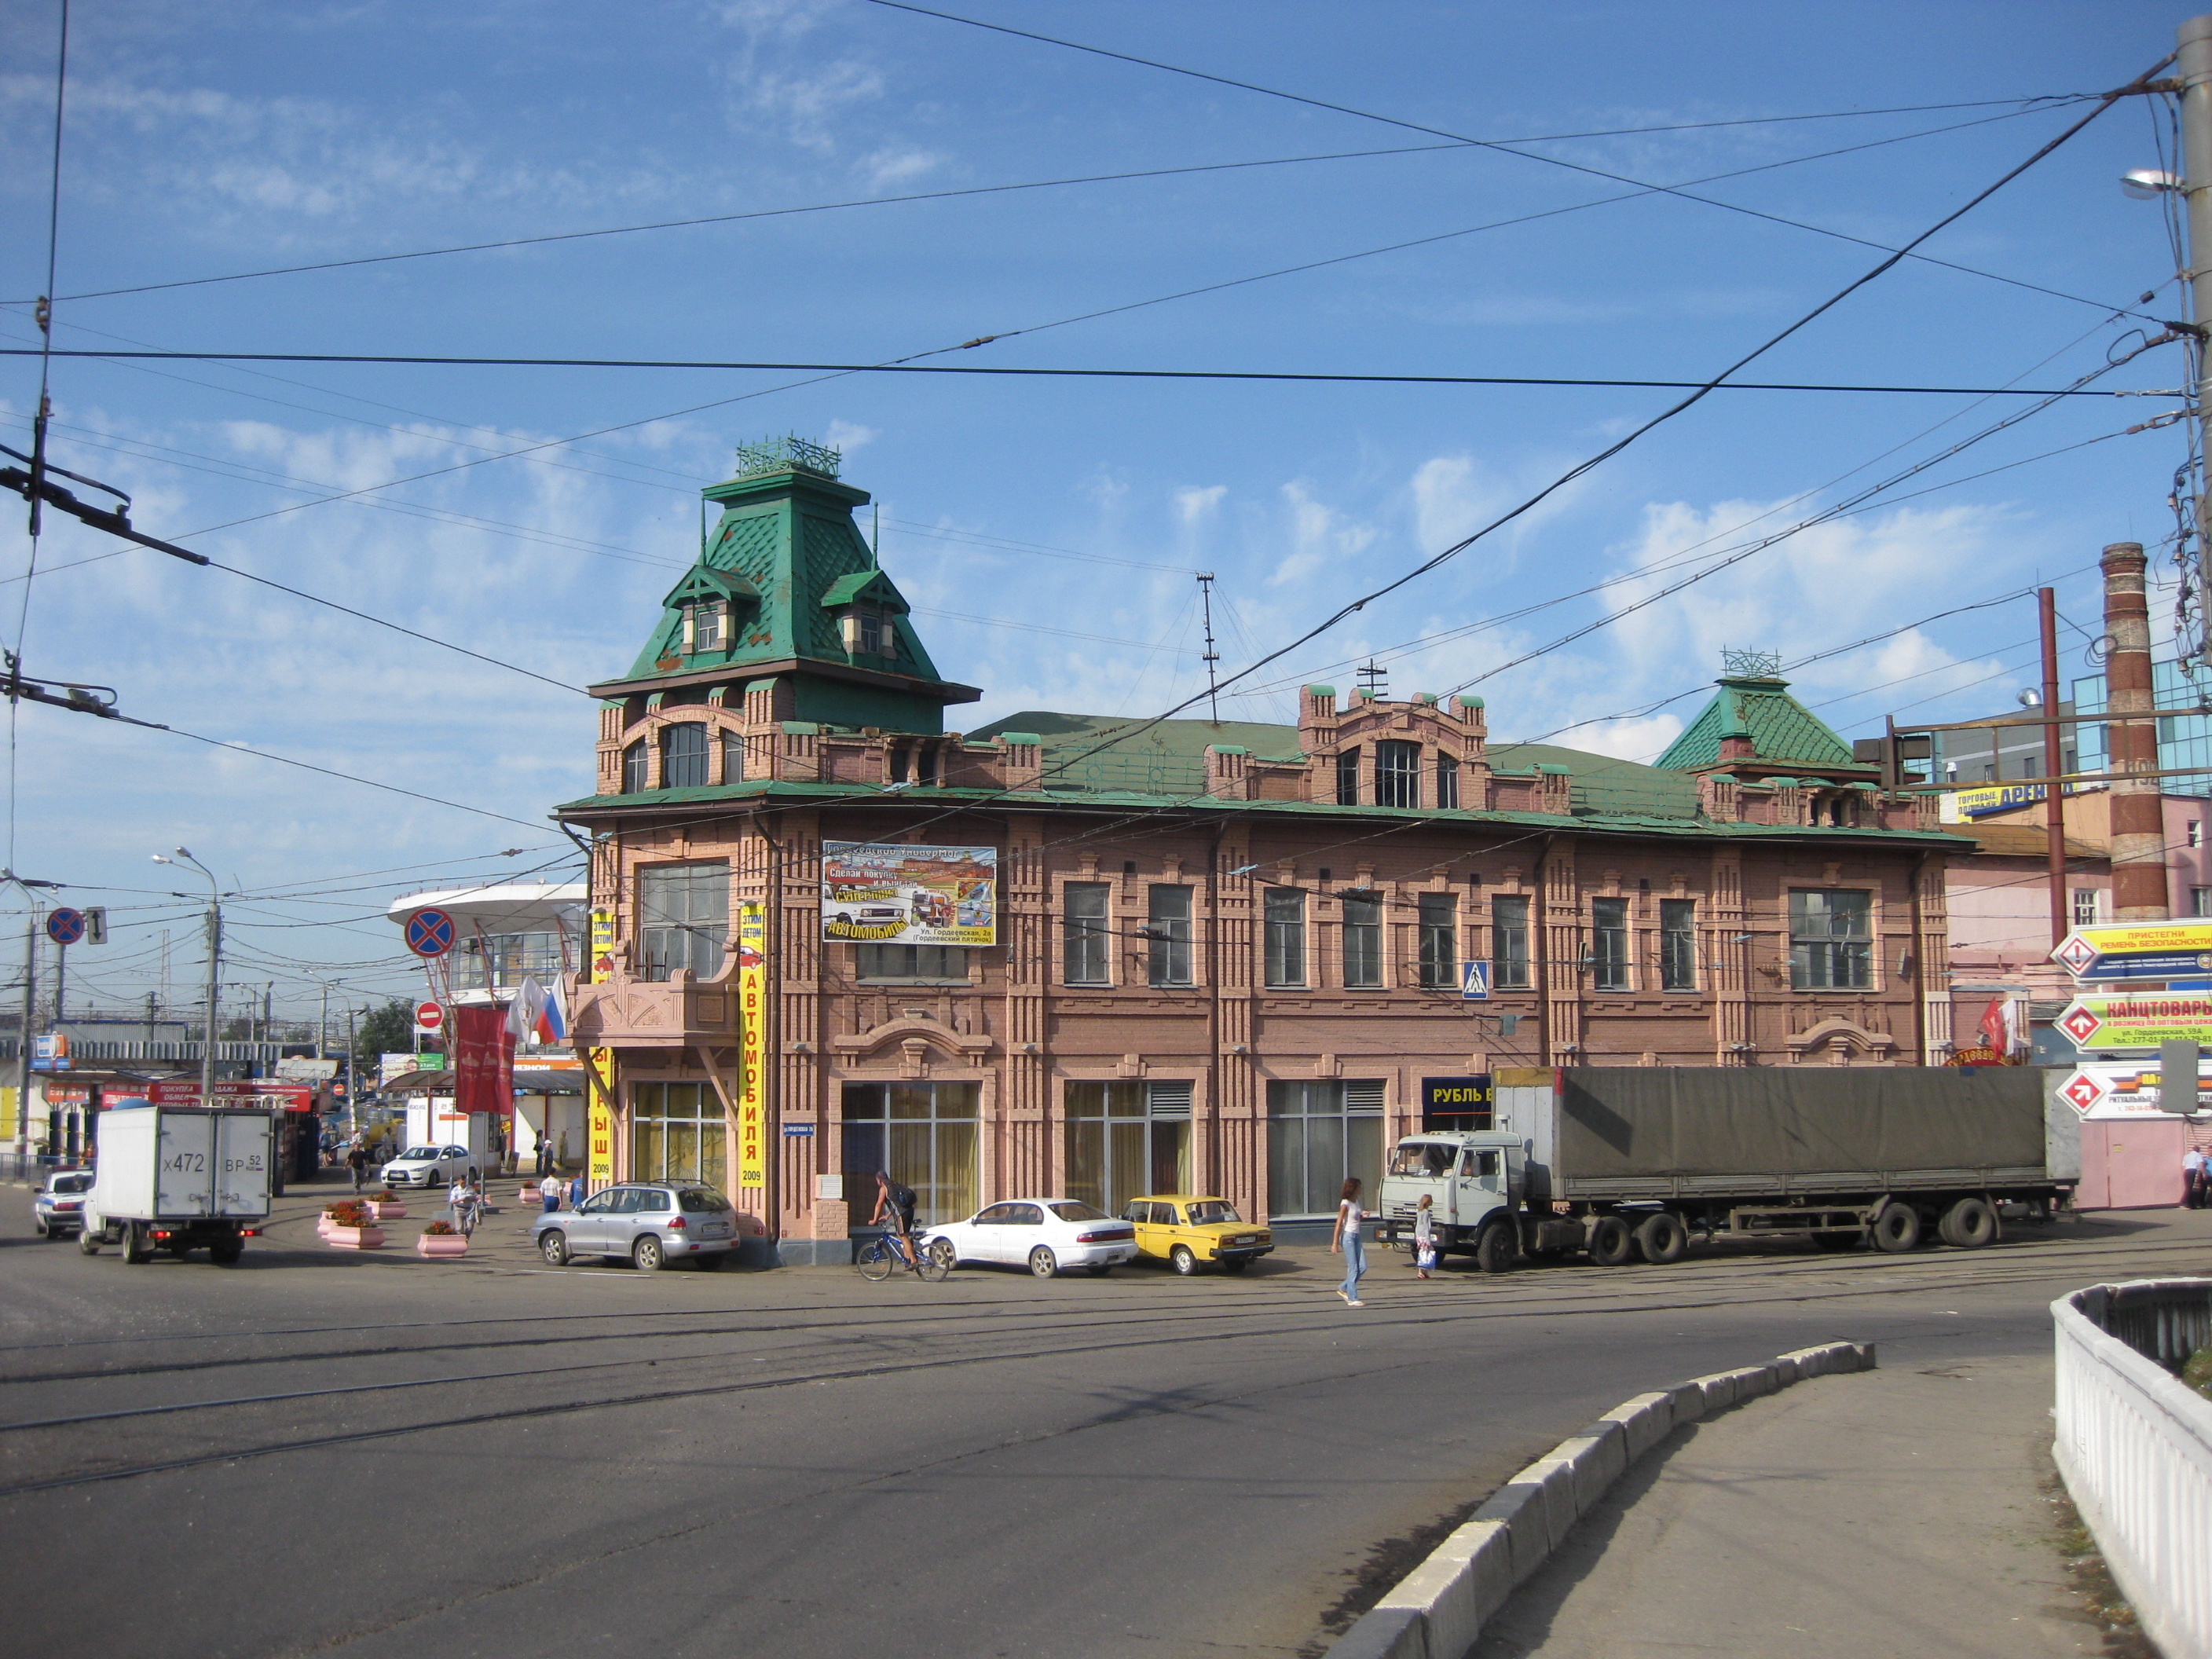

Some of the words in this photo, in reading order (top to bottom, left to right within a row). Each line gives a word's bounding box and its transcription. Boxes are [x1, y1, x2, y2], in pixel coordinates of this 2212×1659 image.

[2001, 785, 2075, 805] АРЕНА
[743, 914, 762, 925] ЭТИМ
[594, 921, 612, 932] ЭТИМ
[828, 917, 910, 939] АВТОМОБИЛЬ!
[742, 928, 762, 938] ЛЕТОМ
[2128, 931, 2185, 939] ПРИСТЕГНИ
[594, 935, 612, 944] ЛЕТОМ
[745, 974, 757, 1160] АВТОМОБИЛЯ
[1434, 1088, 1482, 1103] РУБЛЬ
[225, 1159, 244, 1171] ВР
[249, 1155, 261, 1165] 52
[593, 1164, 610, 1174] 2009
[742, 1170, 761, 1181] 2009
